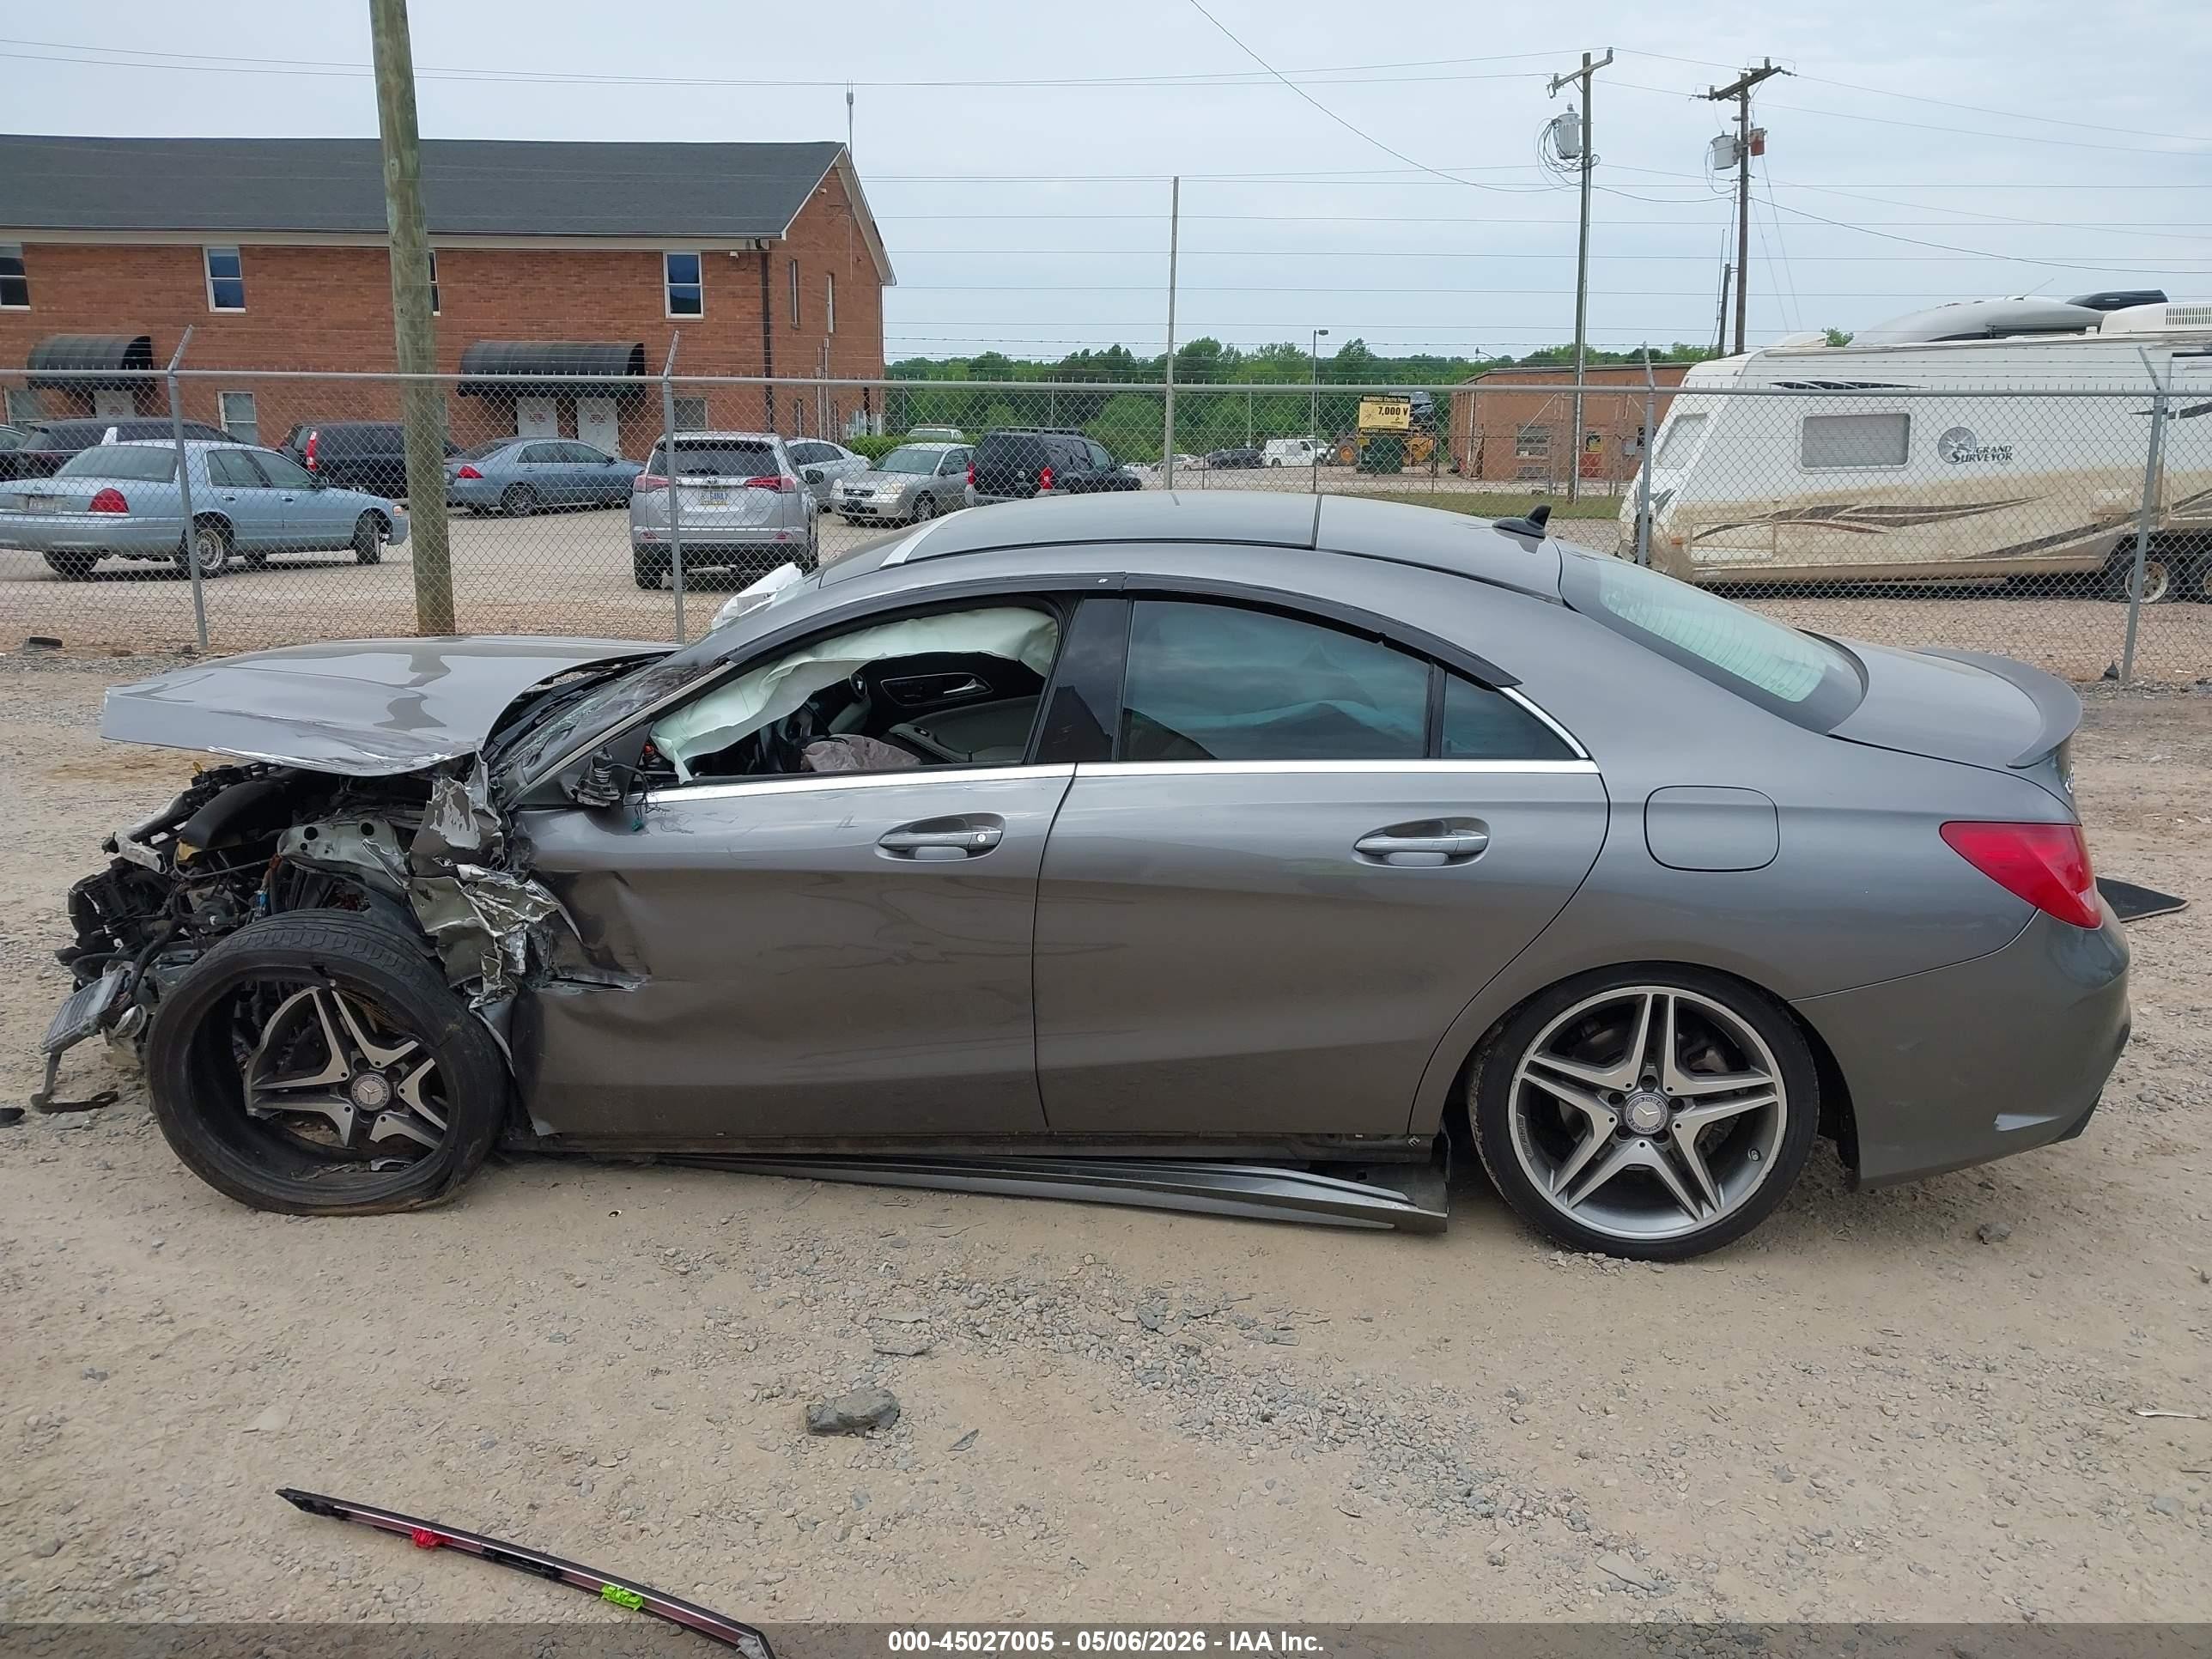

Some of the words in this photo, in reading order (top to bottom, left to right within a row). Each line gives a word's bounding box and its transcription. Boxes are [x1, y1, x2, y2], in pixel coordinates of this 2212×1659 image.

[1378, 406, 1401, 416] 7,000
[1403, 407, 1408, 416] V
[1976, 446, 2012, 454] GRAND
[1952, 450, 2013, 463] SURVEYOR
